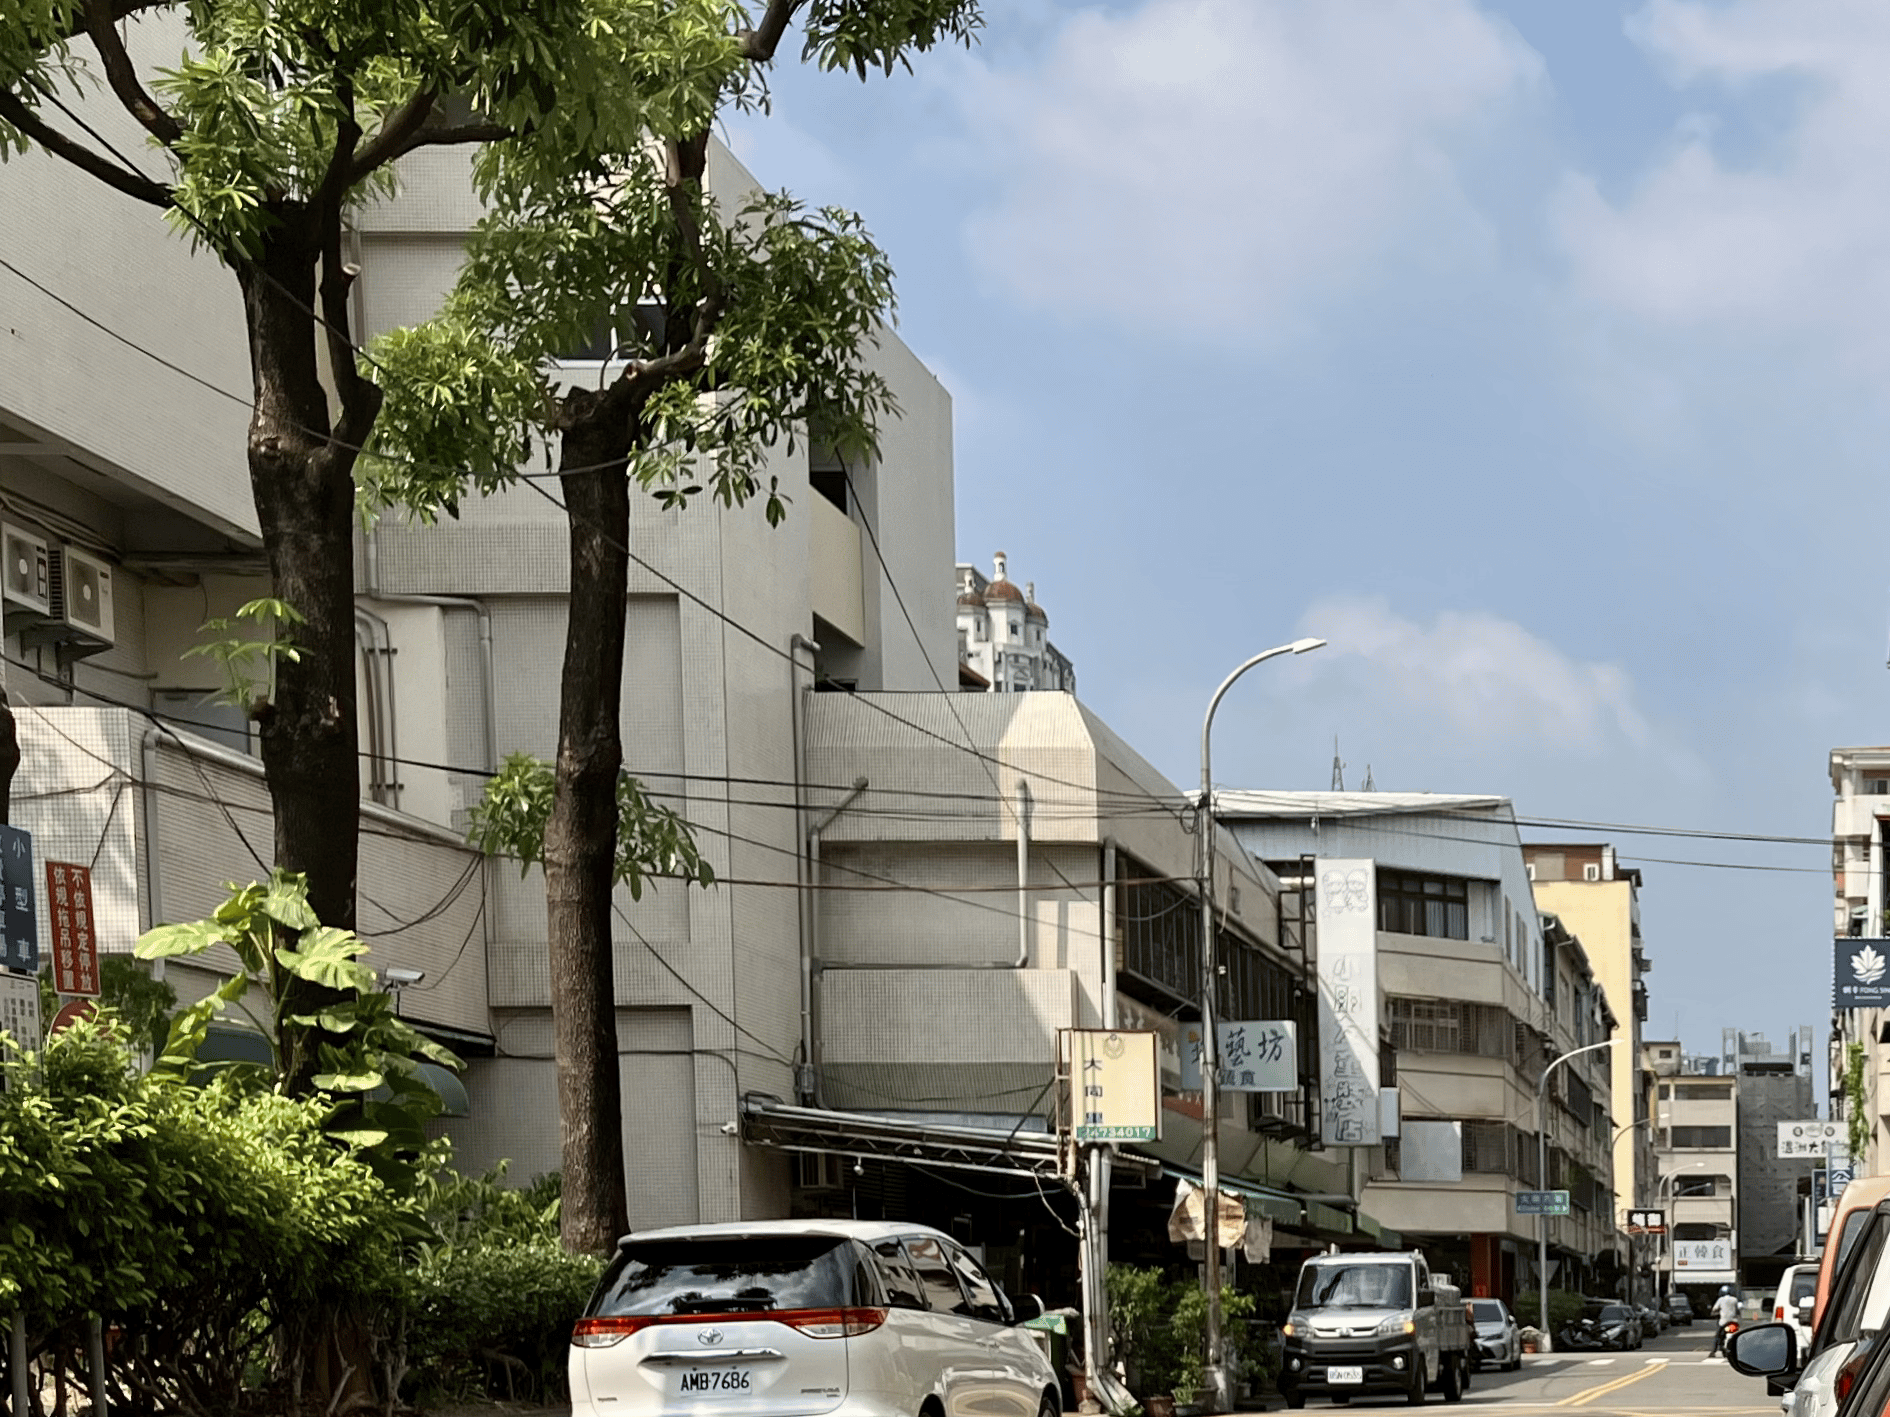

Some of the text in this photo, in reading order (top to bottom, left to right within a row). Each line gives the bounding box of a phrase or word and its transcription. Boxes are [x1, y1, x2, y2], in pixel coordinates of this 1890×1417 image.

[12, 837, 31, 962] 小型車
[53, 865, 75, 991] 依規拖吊移置
[71, 868, 93, 992] 不依規定停放
